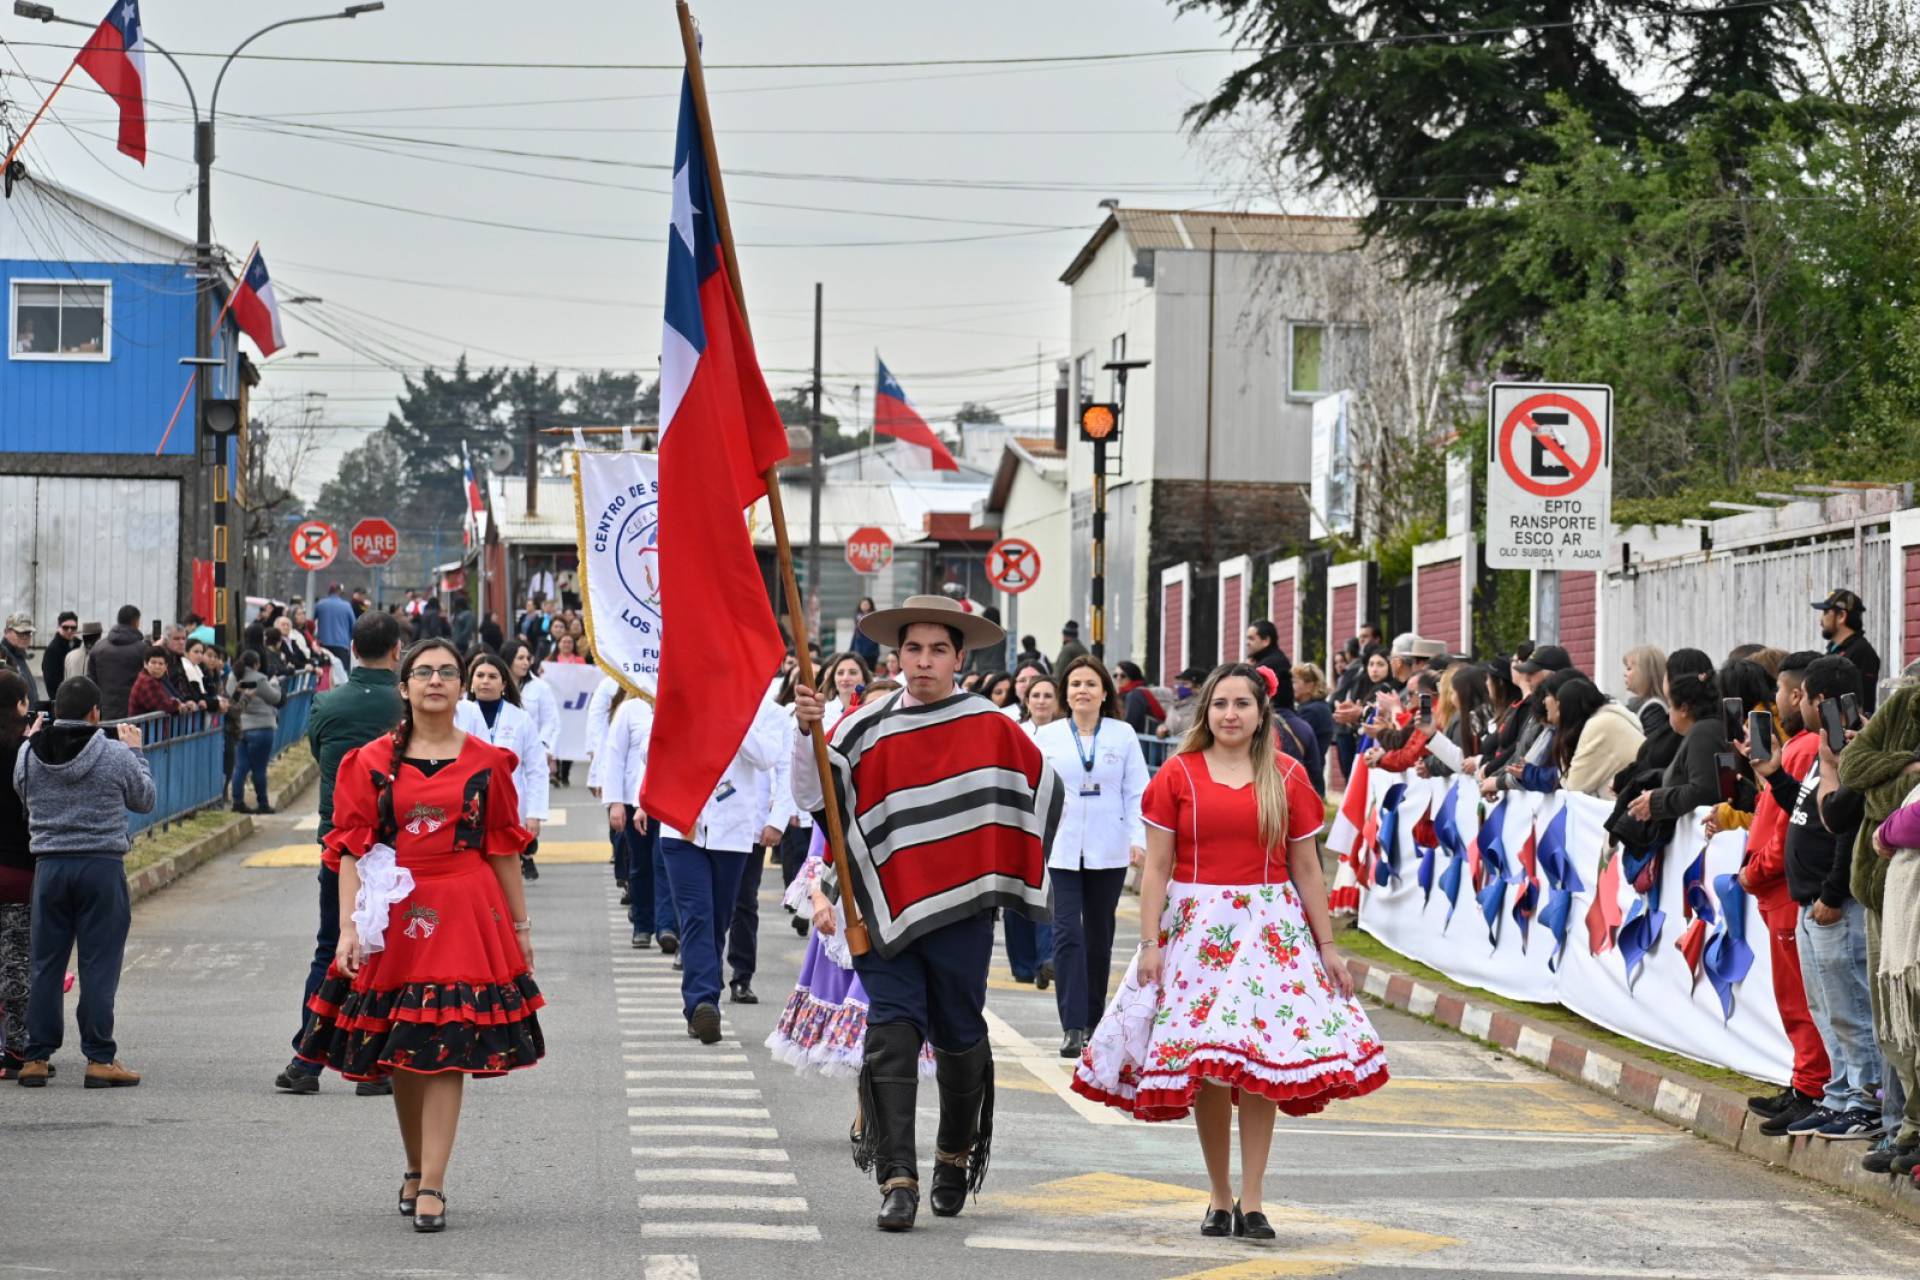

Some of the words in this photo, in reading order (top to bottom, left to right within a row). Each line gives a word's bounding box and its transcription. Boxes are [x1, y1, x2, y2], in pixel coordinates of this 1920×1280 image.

[595, 495, 626, 552] CENTRO
[628, 483, 646, 498] DE
[353, 534, 395, 550] PARE
[1521, 548, 1553, 557] SUBIDA
[621, 608, 651, 634] LOS
